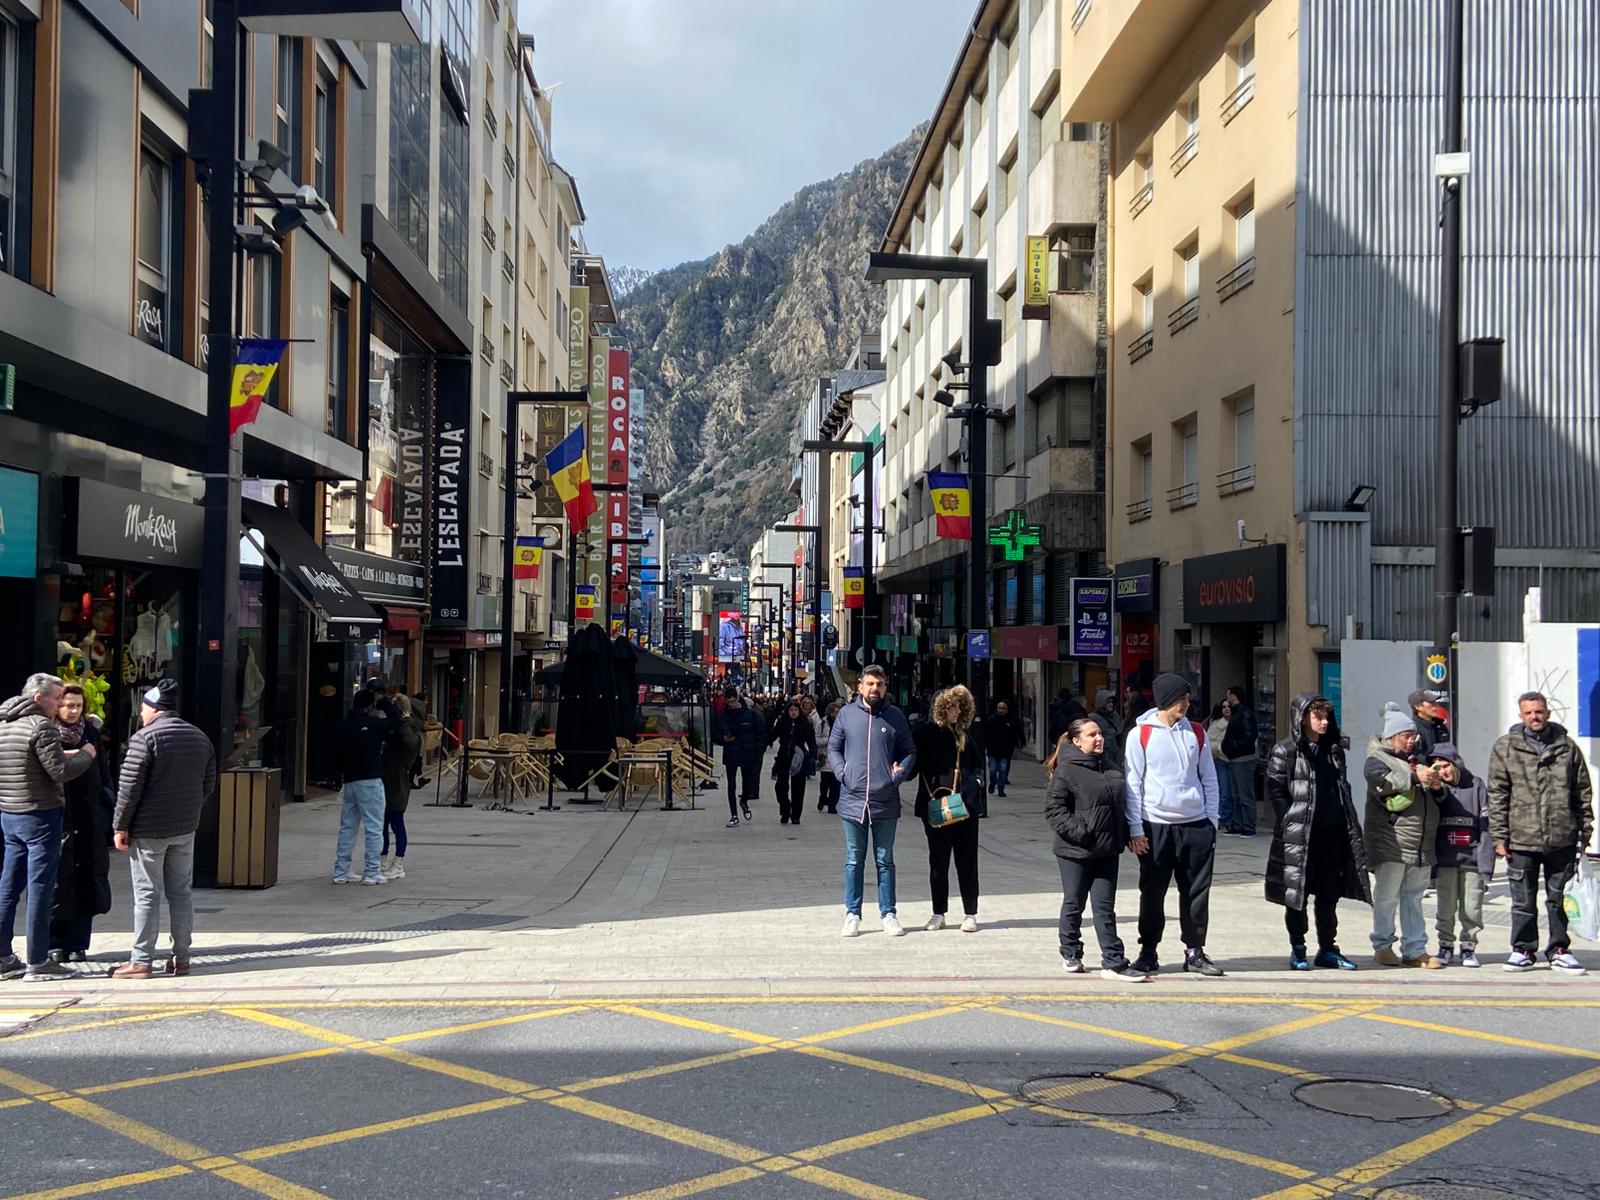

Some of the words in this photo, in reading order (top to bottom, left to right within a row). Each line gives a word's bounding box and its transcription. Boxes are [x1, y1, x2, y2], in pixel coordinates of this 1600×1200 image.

[570, 307, 584, 348] 120
[593, 354, 606, 389] 120
[611, 376, 626, 451] ROCA
[544, 434, 557, 514] REX
[1080, 628, 1106, 639] Funko
